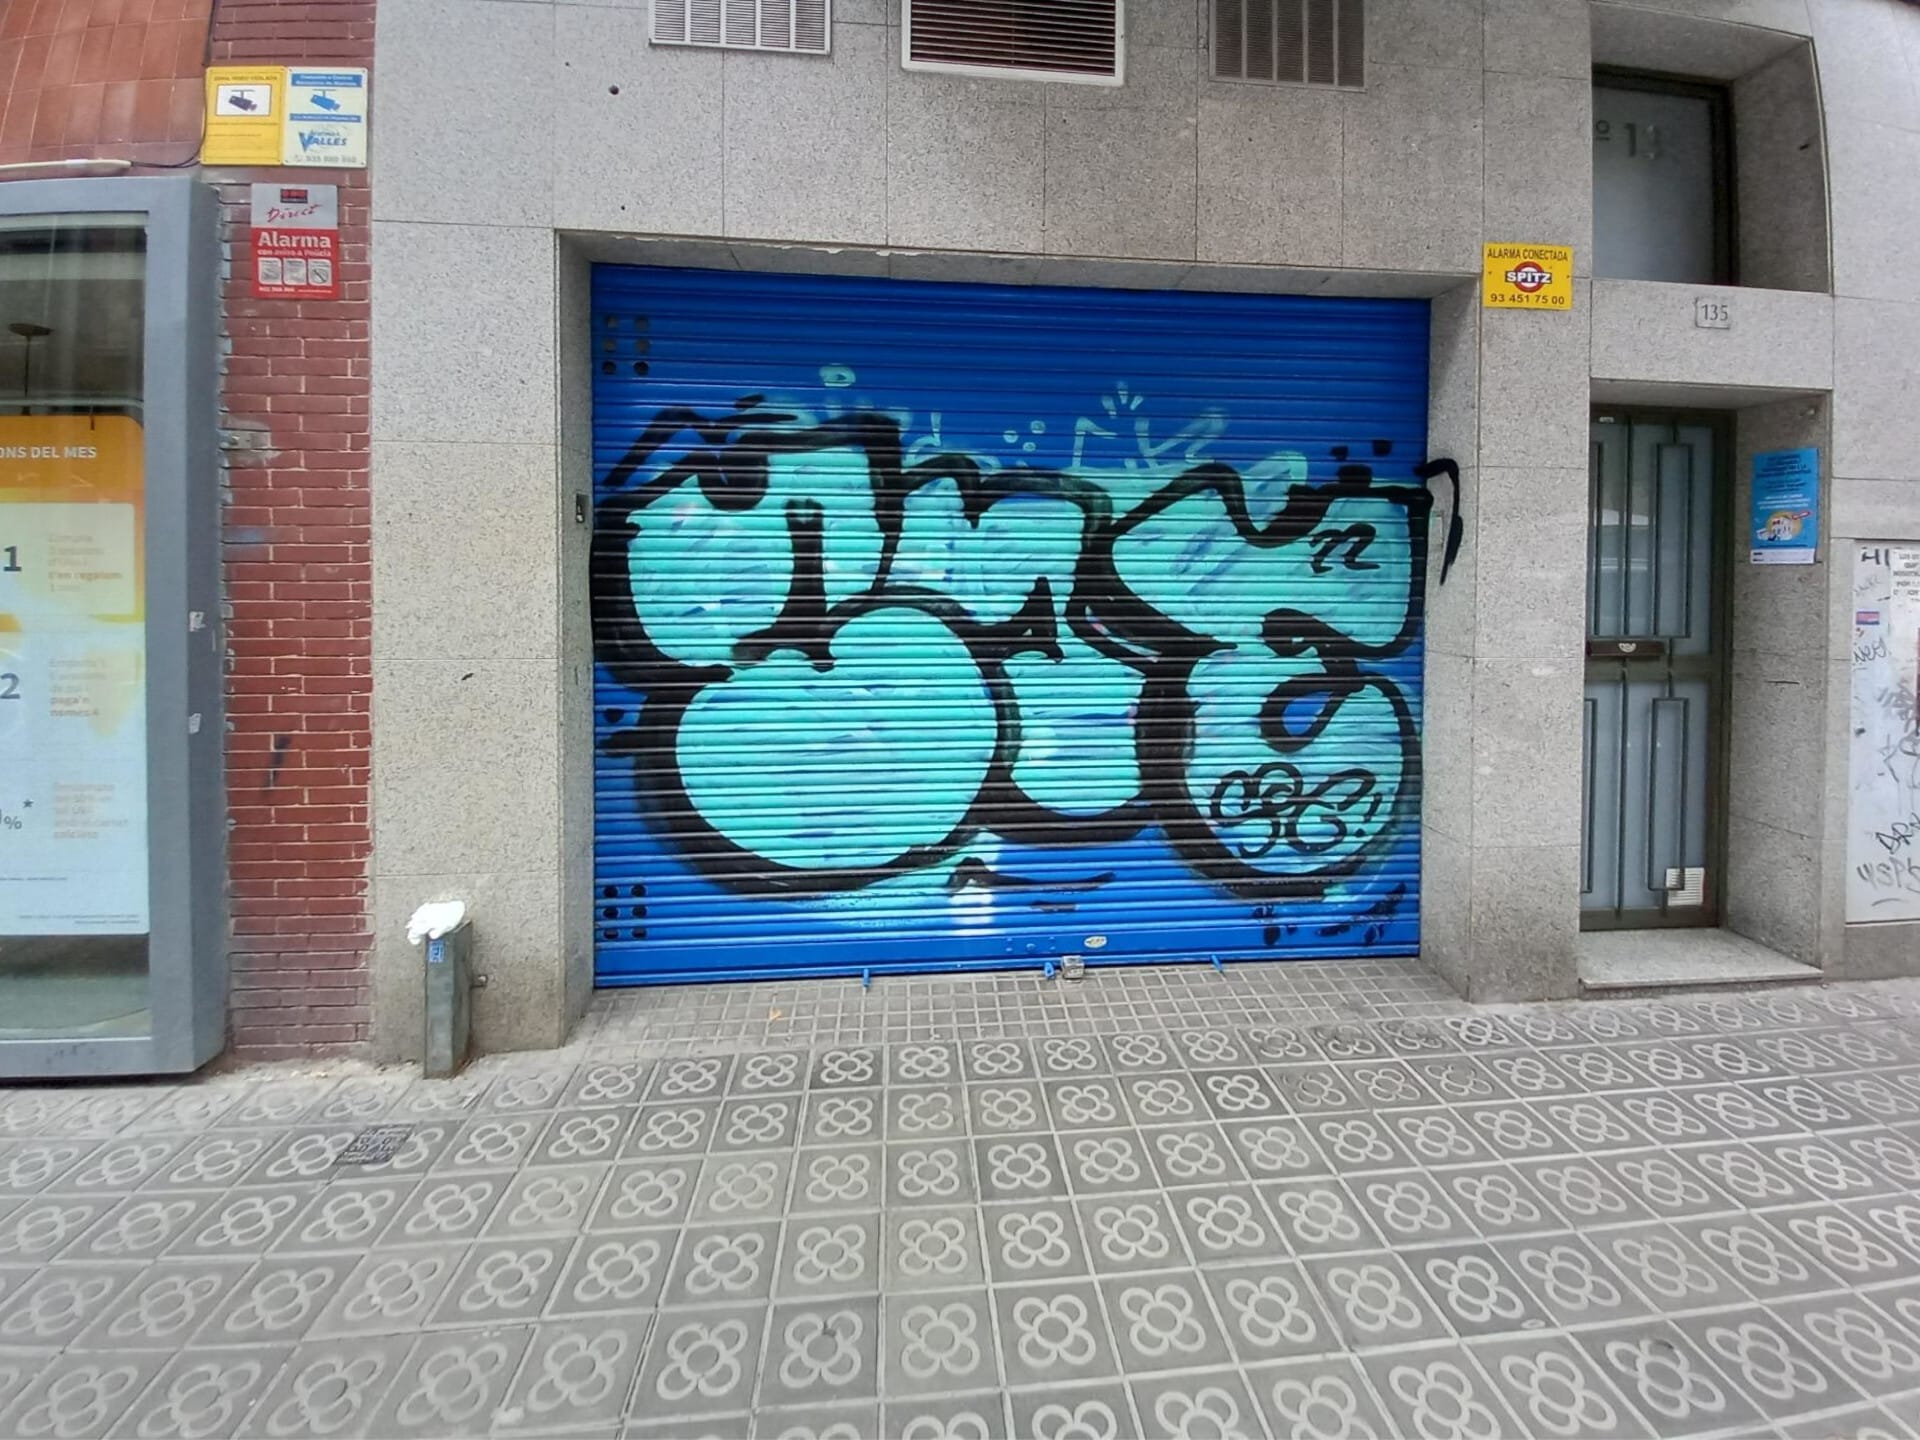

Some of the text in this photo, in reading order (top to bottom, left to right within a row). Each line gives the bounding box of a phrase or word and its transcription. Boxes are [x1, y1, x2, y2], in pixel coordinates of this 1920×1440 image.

[258, 231, 331, 248] Alarma
[1487, 247, 1569, 262] ALARMA CONECTADA
[1506, 271, 1552, 284] SPITZ
[1490, 293, 1565, 305] 93 451 75 00
[1701, 303, 1729, 321] 135
[31, 446, 60, 459] DEL
[63, 446, 98, 459] MES
[3, 546, 22, 572] 1
[0, 673, 20, 699] 2
